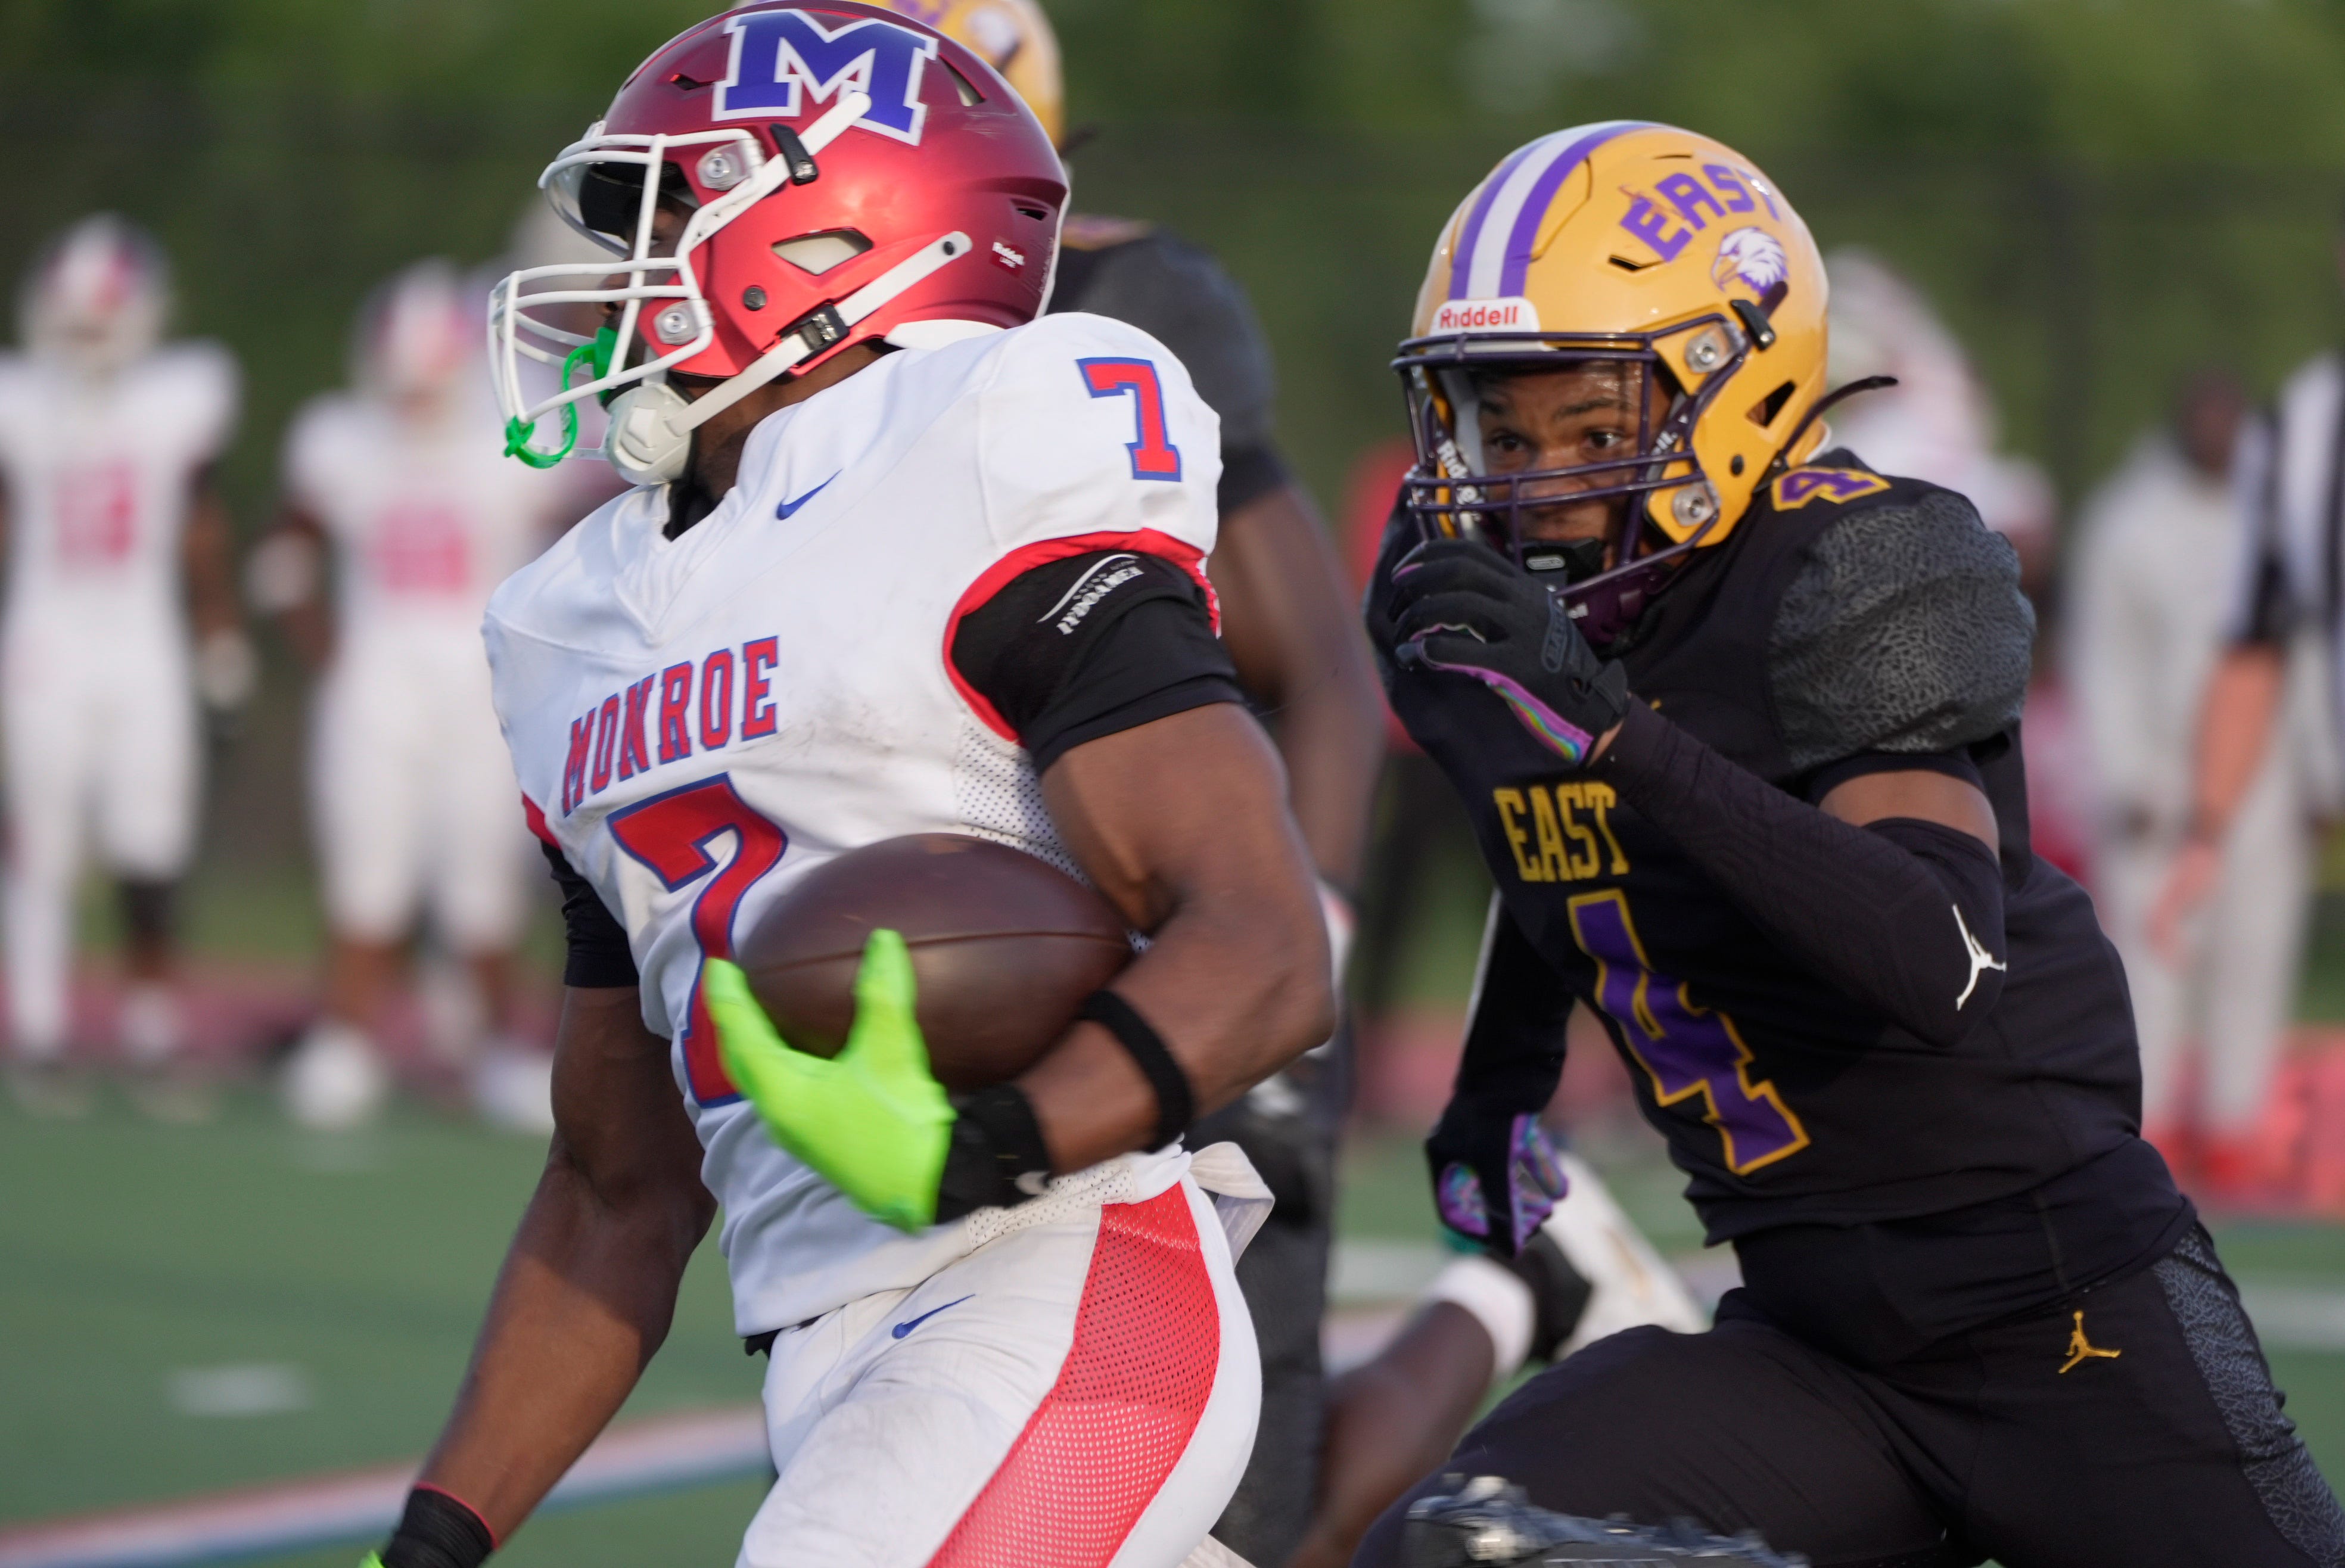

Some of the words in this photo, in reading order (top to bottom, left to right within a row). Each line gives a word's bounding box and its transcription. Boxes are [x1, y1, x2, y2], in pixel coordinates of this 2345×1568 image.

[712, 8, 939, 147] M
[1439, 306, 1519, 329] Riddell
[1075, 357, 1182, 482] 7
[1771, 466, 1893, 512] 4
[562, 635, 779, 817] MONROE
[1493, 782, 1631, 882] EAST
[607, 771, 788, 1109] 7
[1567, 888, 1811, 1175] 4
